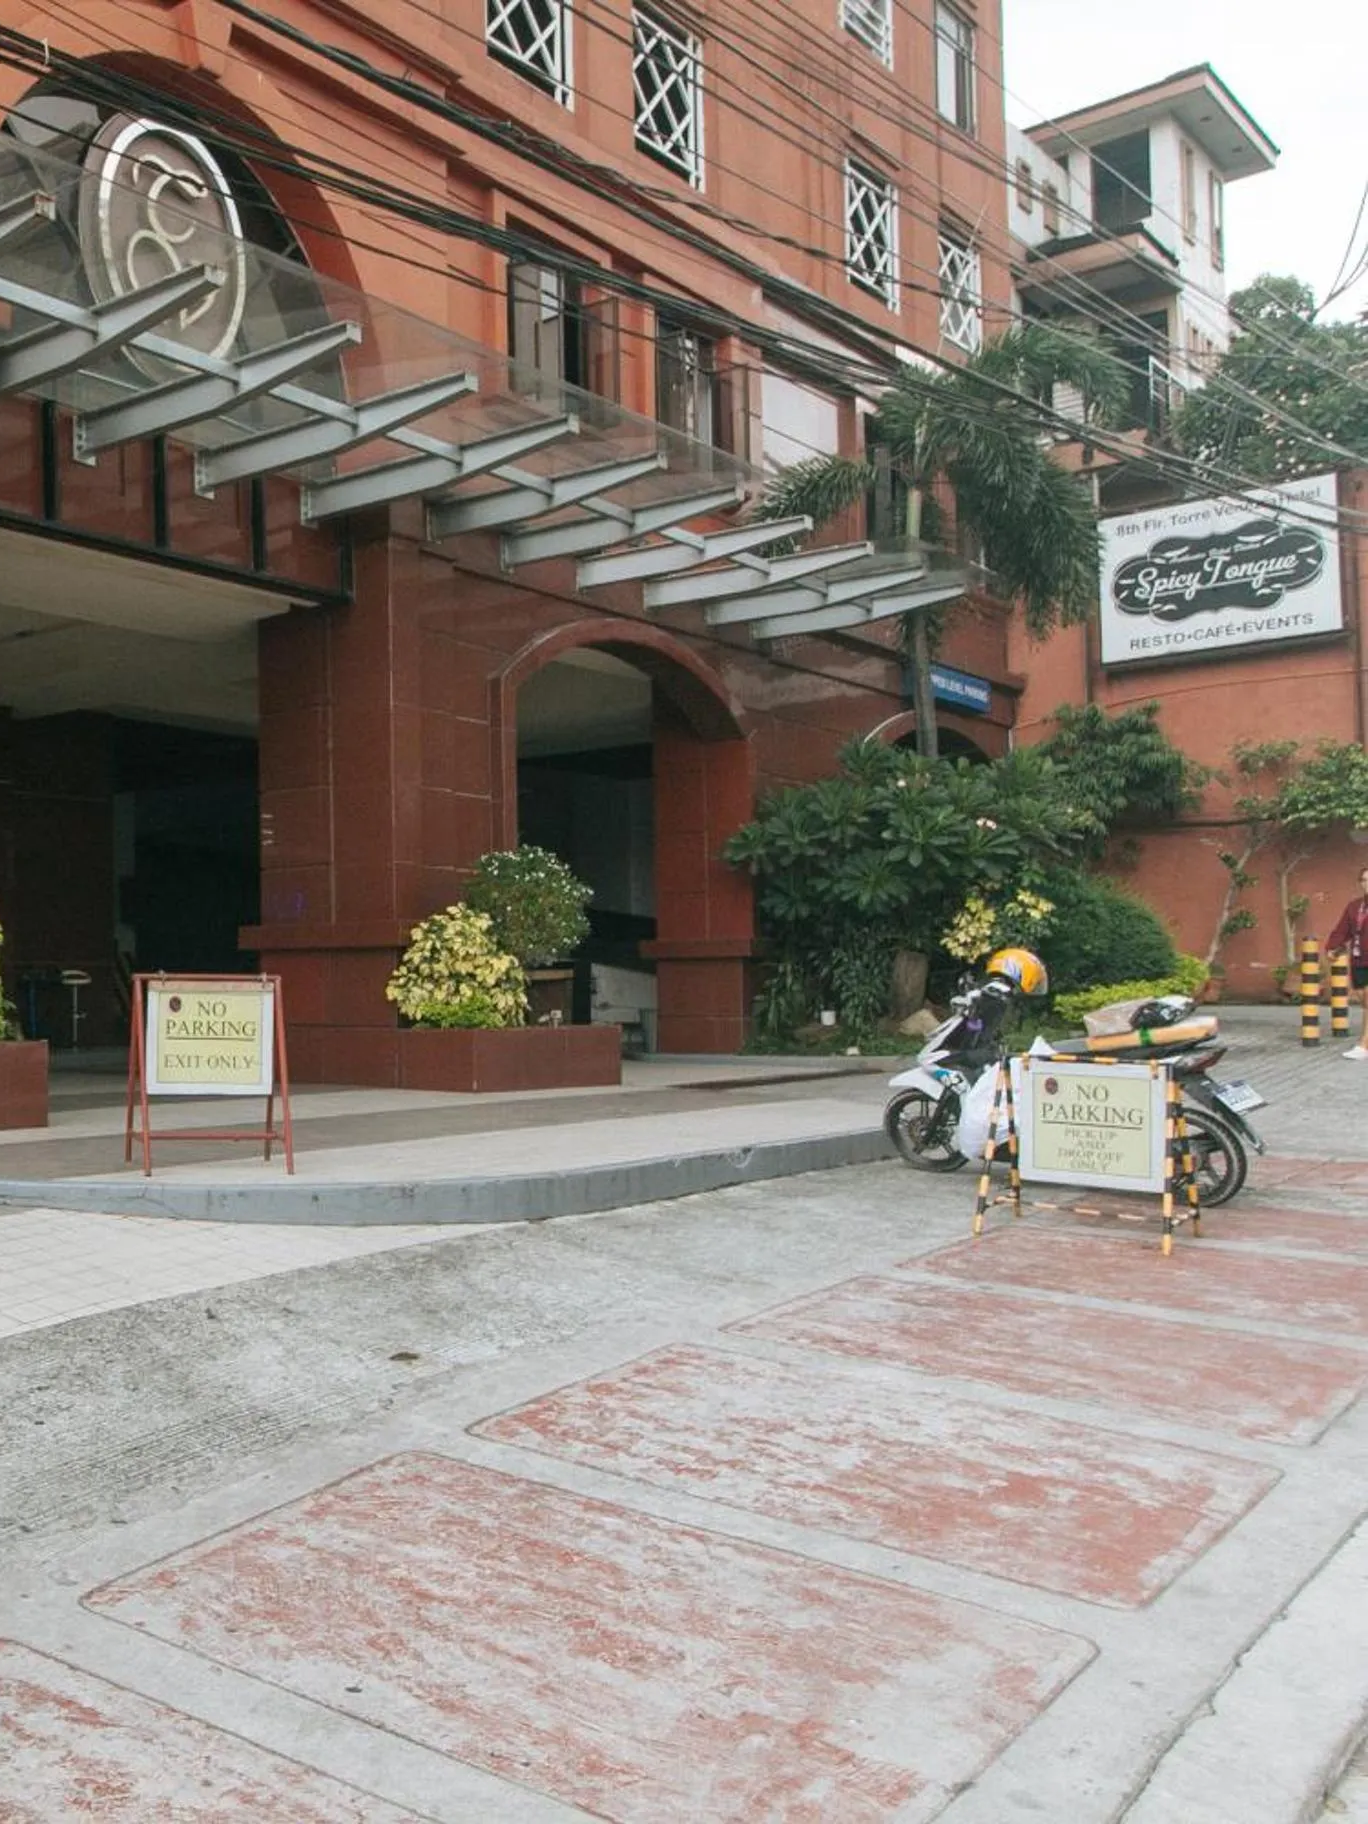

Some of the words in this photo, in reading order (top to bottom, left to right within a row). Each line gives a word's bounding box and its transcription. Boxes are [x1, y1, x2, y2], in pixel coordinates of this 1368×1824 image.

[1134, 566, 1202, 605] Spicy
[1203, 552, 1299, 589] Tongue
[197, 1000, 227, 1017] NO
[165, 1019, 257, 1037] PARKING
[163, 1054, 205, 1069] EXIT
[206, 1054, 254, 1070] ONLY
[1076, 1083, 1110, 1102] NO
[1041, 1102, 1144, 1126] PARKING
